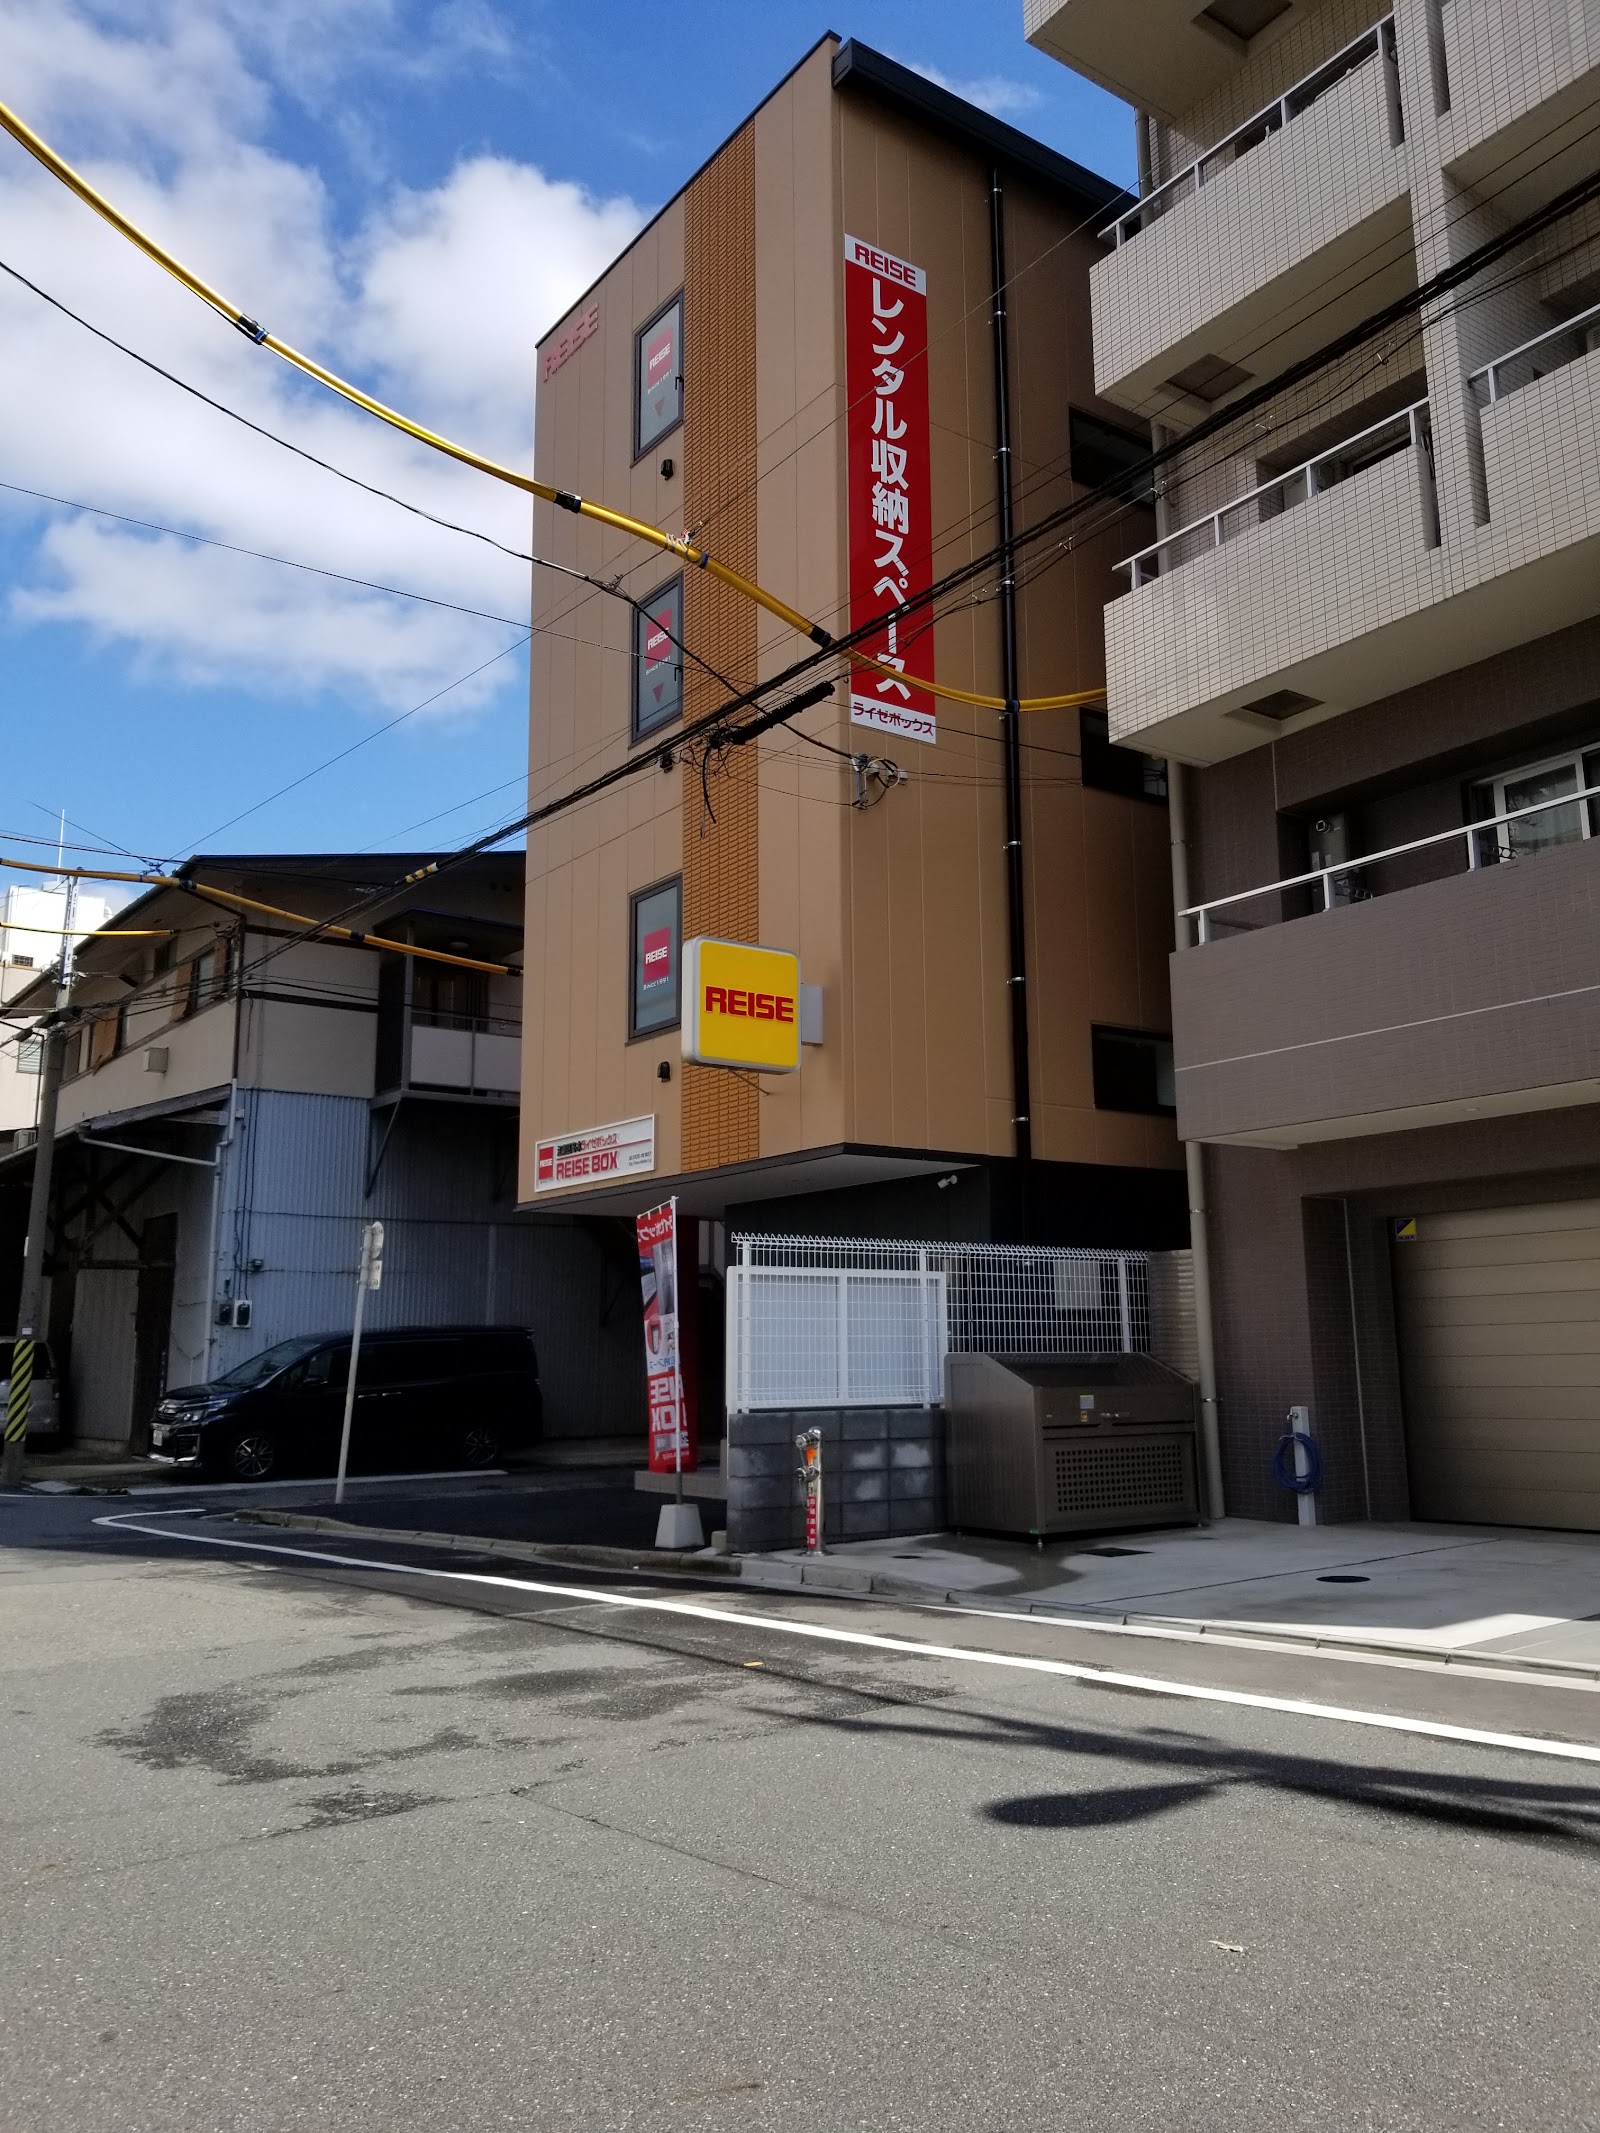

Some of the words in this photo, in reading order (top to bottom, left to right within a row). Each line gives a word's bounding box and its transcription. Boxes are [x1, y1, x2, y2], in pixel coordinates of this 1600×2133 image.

[855, 243, 916, 287] REISE
[649, 343, 671, 371] REISE
[871, 277, 911, 700] レンタル収納スペース
[853, 701, 934, 736] ライゼボックス
[645, 946, 668, 965] REISE
[705, 985, 794, 1023] REISE
[556, 1157, 590, 1181] REISE
[591, 1151, 618, 1174] BOX
